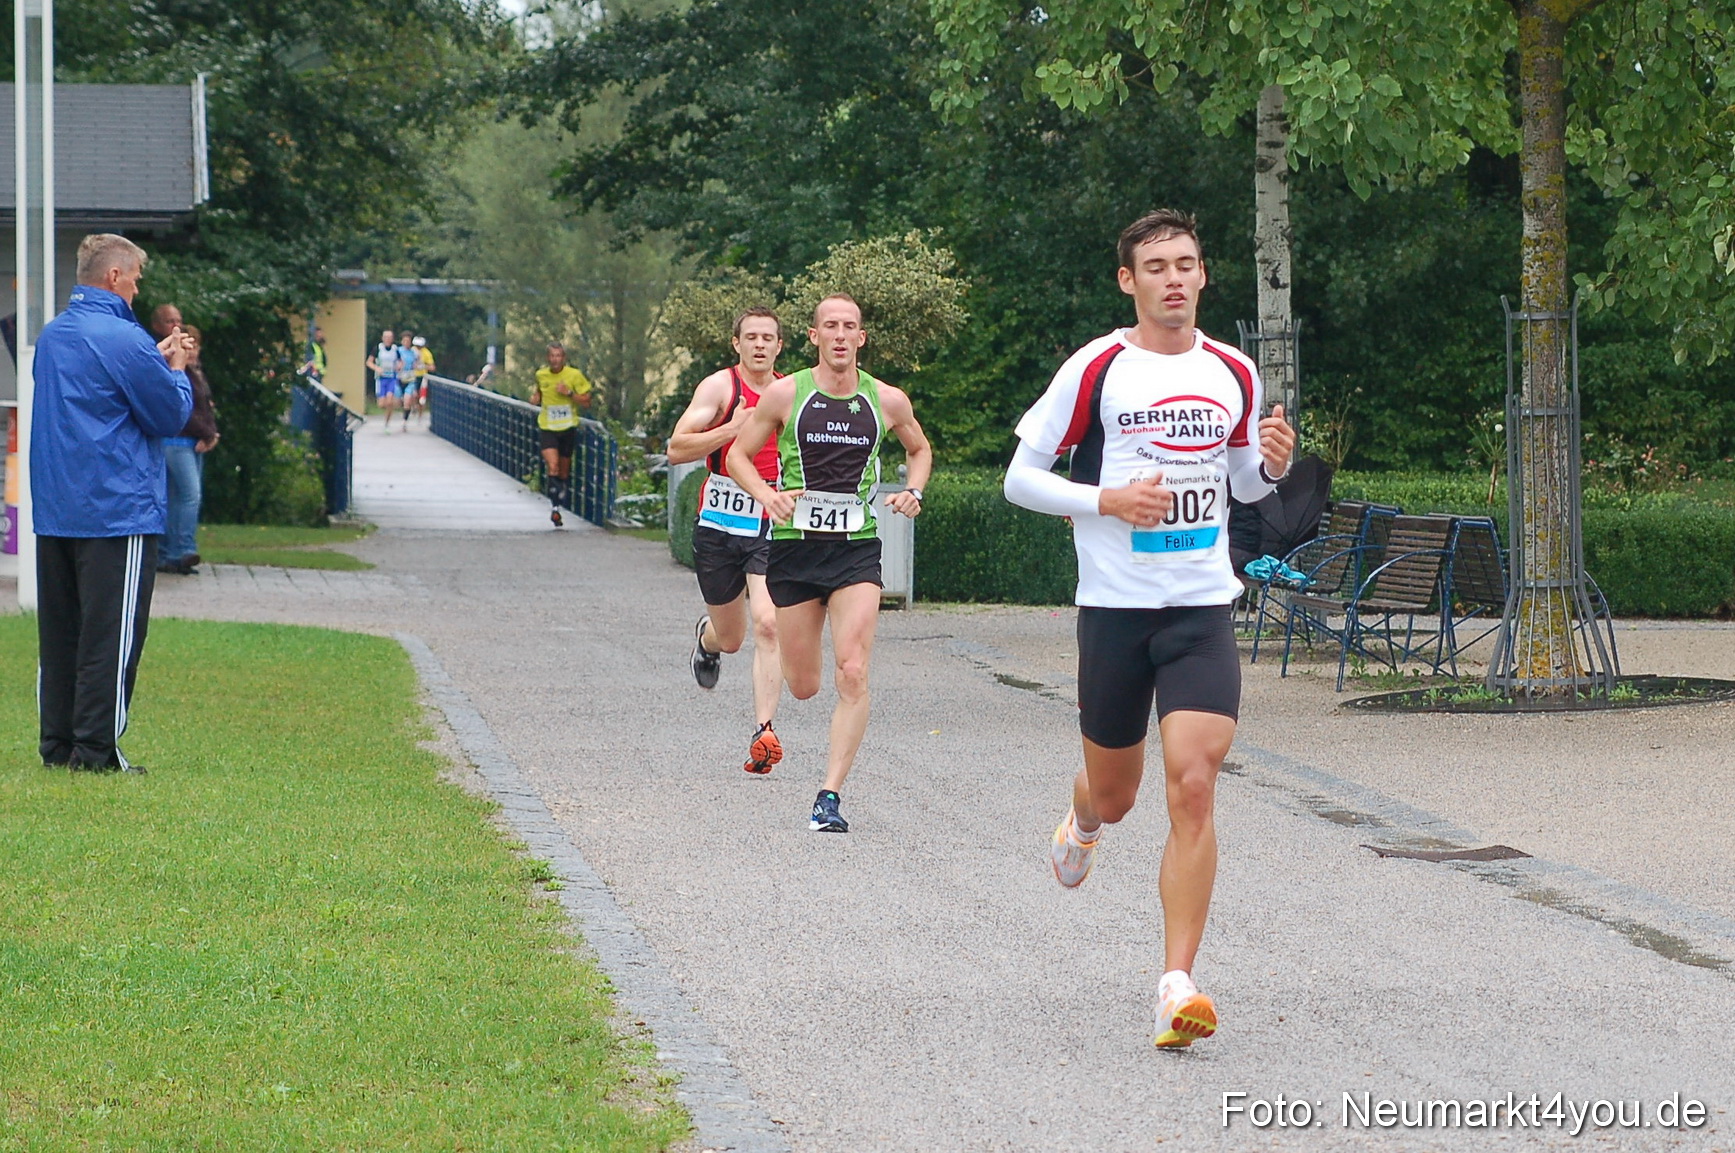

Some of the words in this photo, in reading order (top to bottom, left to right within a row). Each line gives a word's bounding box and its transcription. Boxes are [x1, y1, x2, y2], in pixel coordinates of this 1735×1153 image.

[1118, 409, 1213, 426] GERHART
[1216, 414, 1223, 422] &
[826, 421, 850, 432] DAV
[1120, 425, 1167, 435] Autohaus
[806, 433, 869, 445] Röthenbach
[1136, 446, 1154, 460] Das
[1166, 475, 1211, 485] Neumarkt
[709, 488, 755, 514] 3161
[823, 498, 854, 506] Neumarkt
[809, 506, 848, 530] 541
[1165, 534, 1195, 549] Felix
